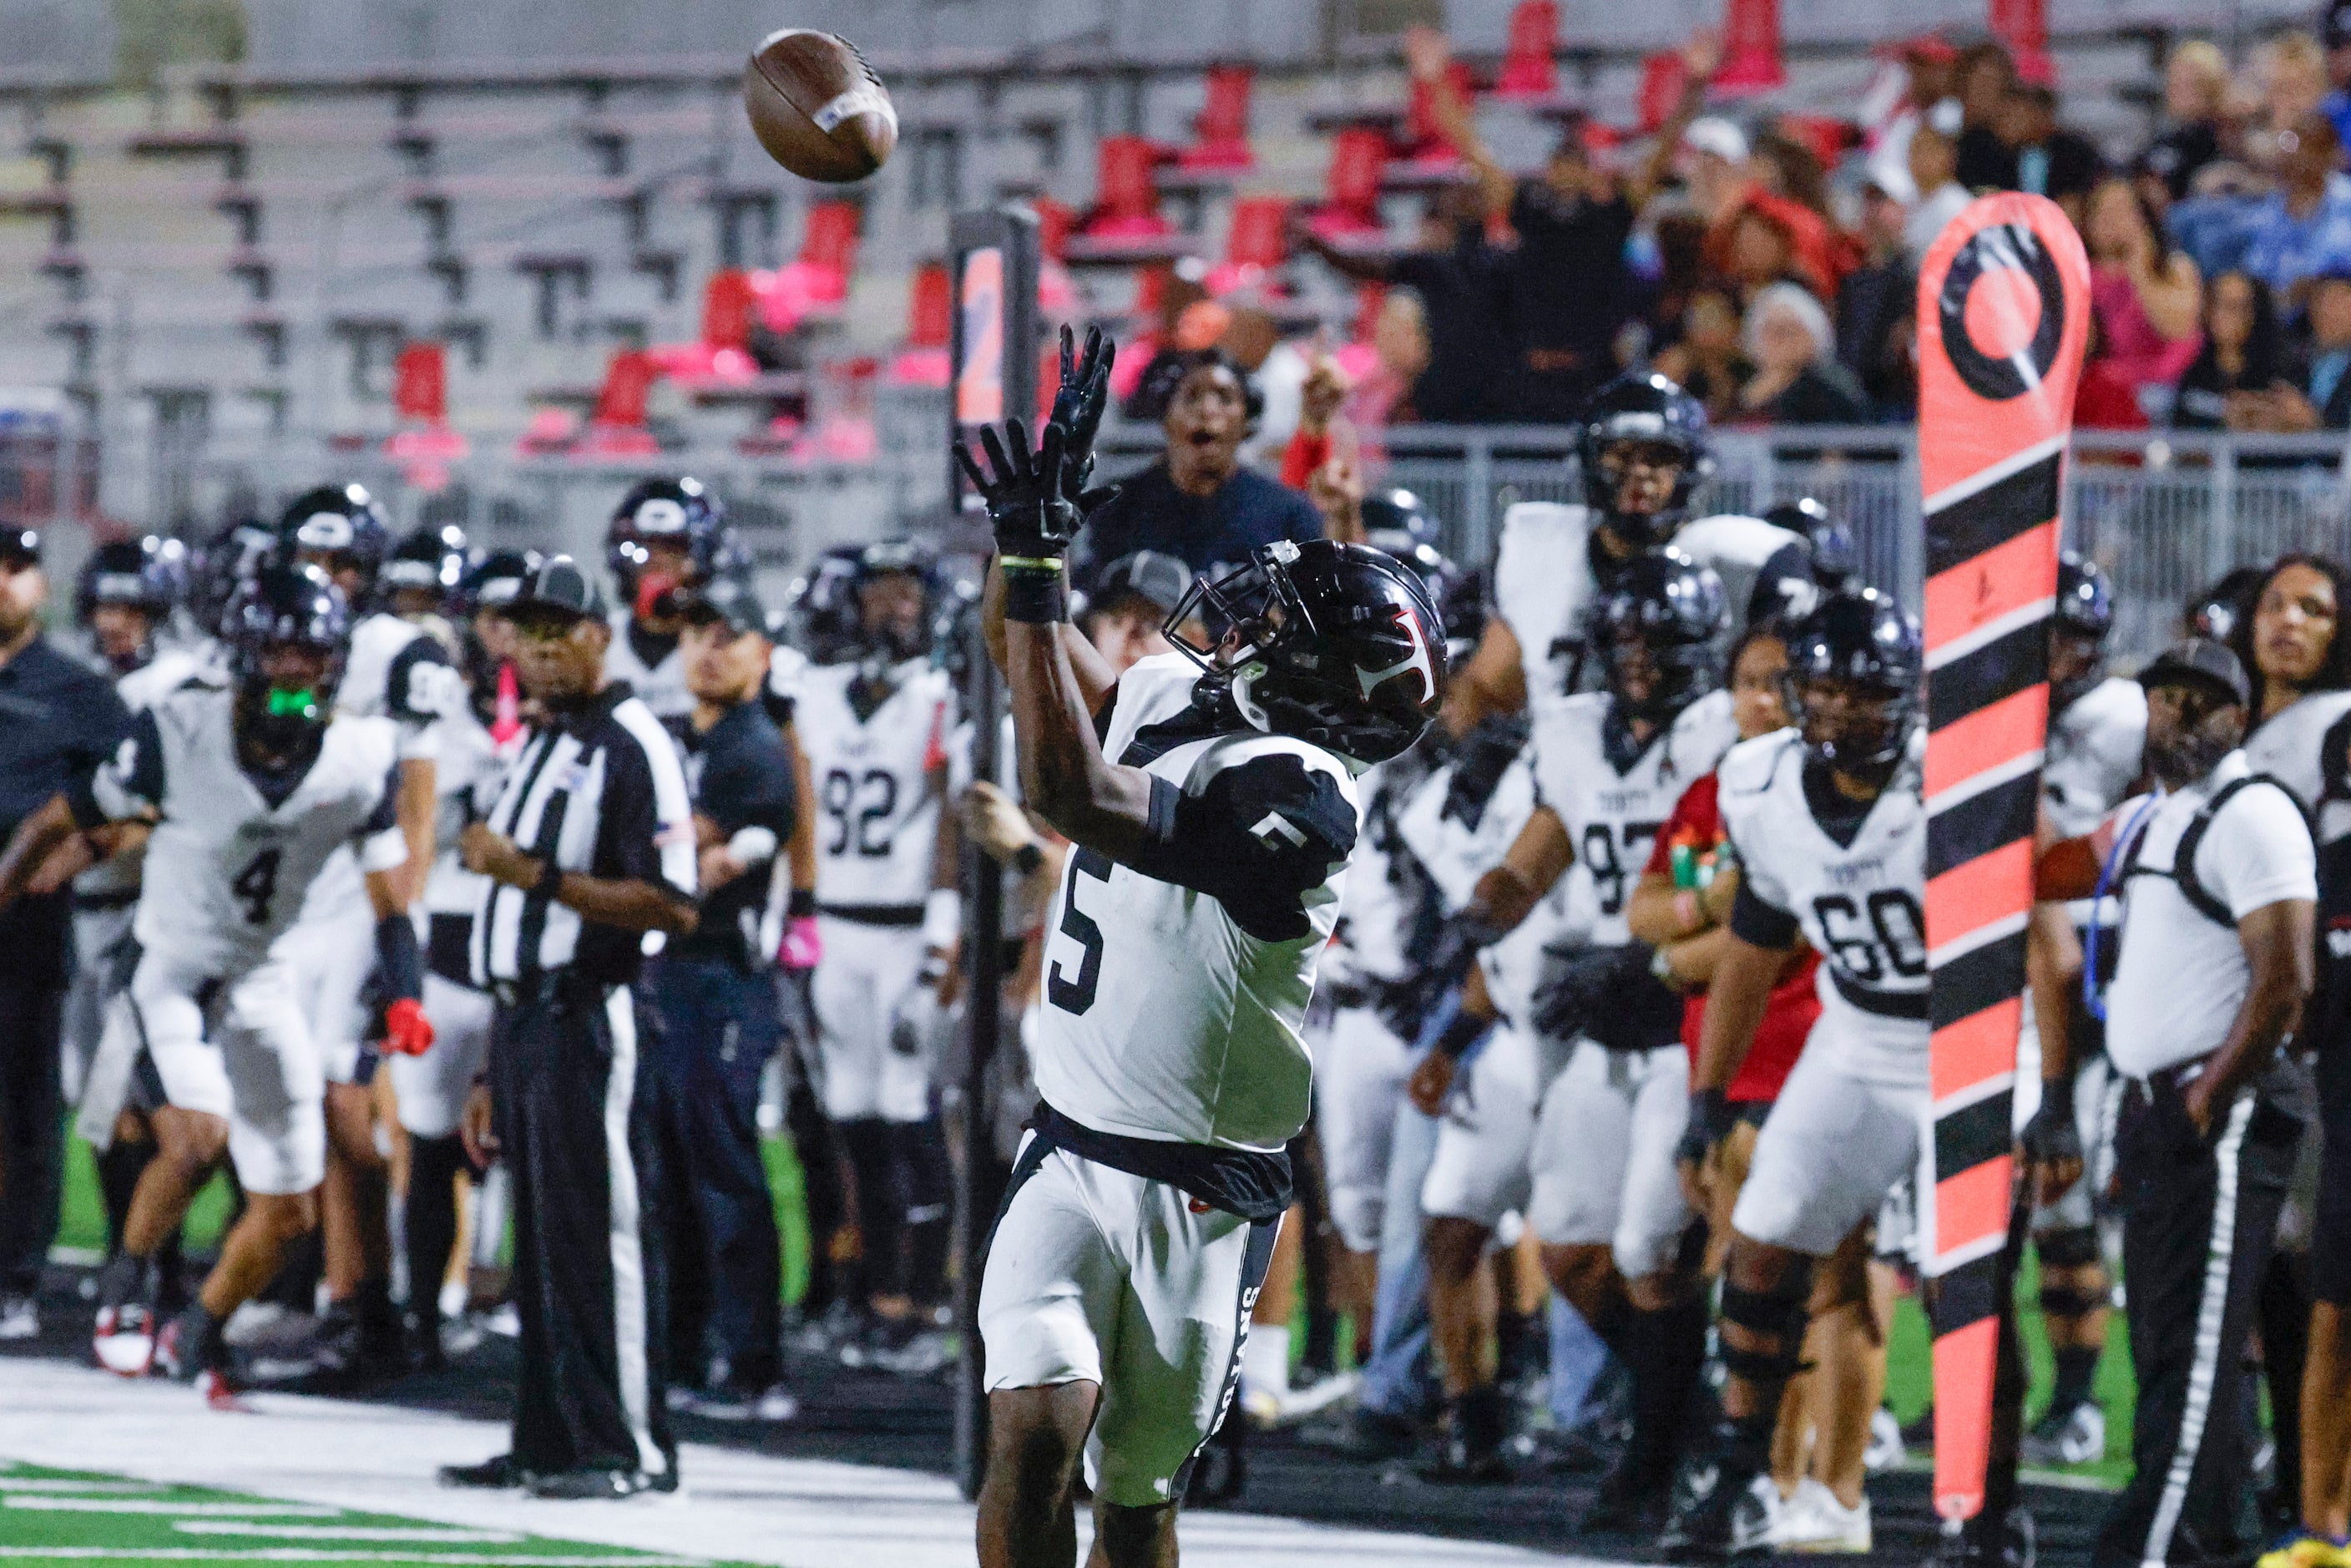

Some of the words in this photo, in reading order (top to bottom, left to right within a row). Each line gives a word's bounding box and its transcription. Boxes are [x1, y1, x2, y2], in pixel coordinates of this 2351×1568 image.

[822, 768, 899, 857] 92
[232, 847, 282, 925] 4
[1048, 843, 1115, 1016] 5
[1812, 888, 1927, 981] 60
